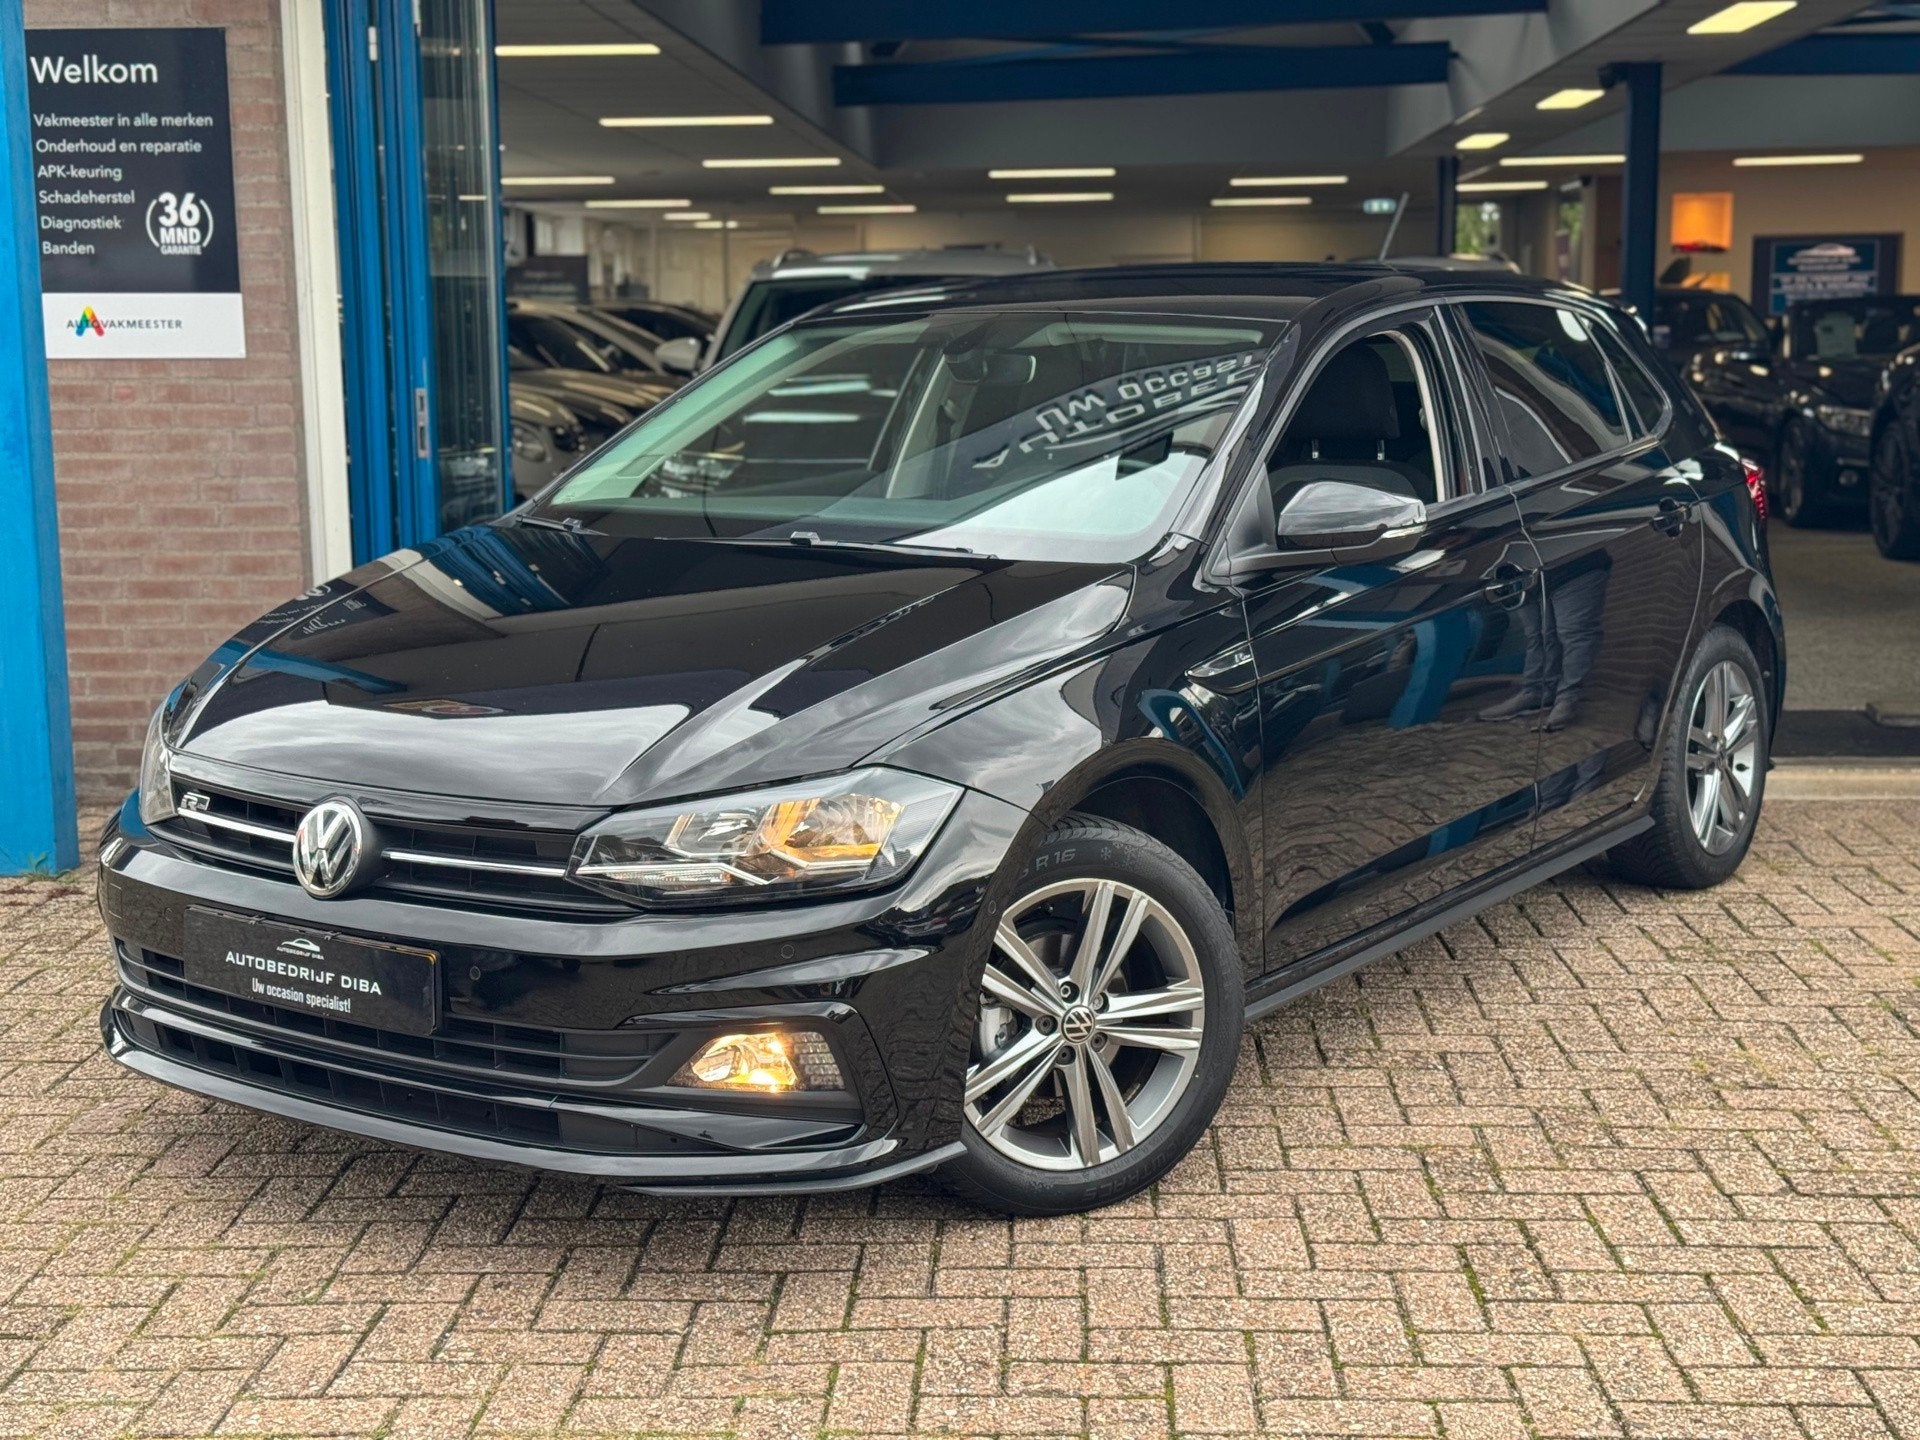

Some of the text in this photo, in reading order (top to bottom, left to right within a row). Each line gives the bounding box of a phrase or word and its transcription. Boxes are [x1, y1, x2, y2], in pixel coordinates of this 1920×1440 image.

[30, 54, 158, 84] Welkom
[33, 112, 214, 128] Vakmeester in alle merken
[36, 138, 202, 155] Onderhoud en reparatie
[37, 164, 122, 182] APK-keuring
[39, 189, 135, 204] Schadeherstel
[158, 191, 201, 227] 36
[40, 215, 122, 233] Diagnostiek
[160, 227, 202, 245] MND
[42, 241, 95, 255] Banden
[225, 951, 382, 996] AUTOBEDRIJF DIBA
[252, 978, 352, 1014] Uw occasion specialist!
